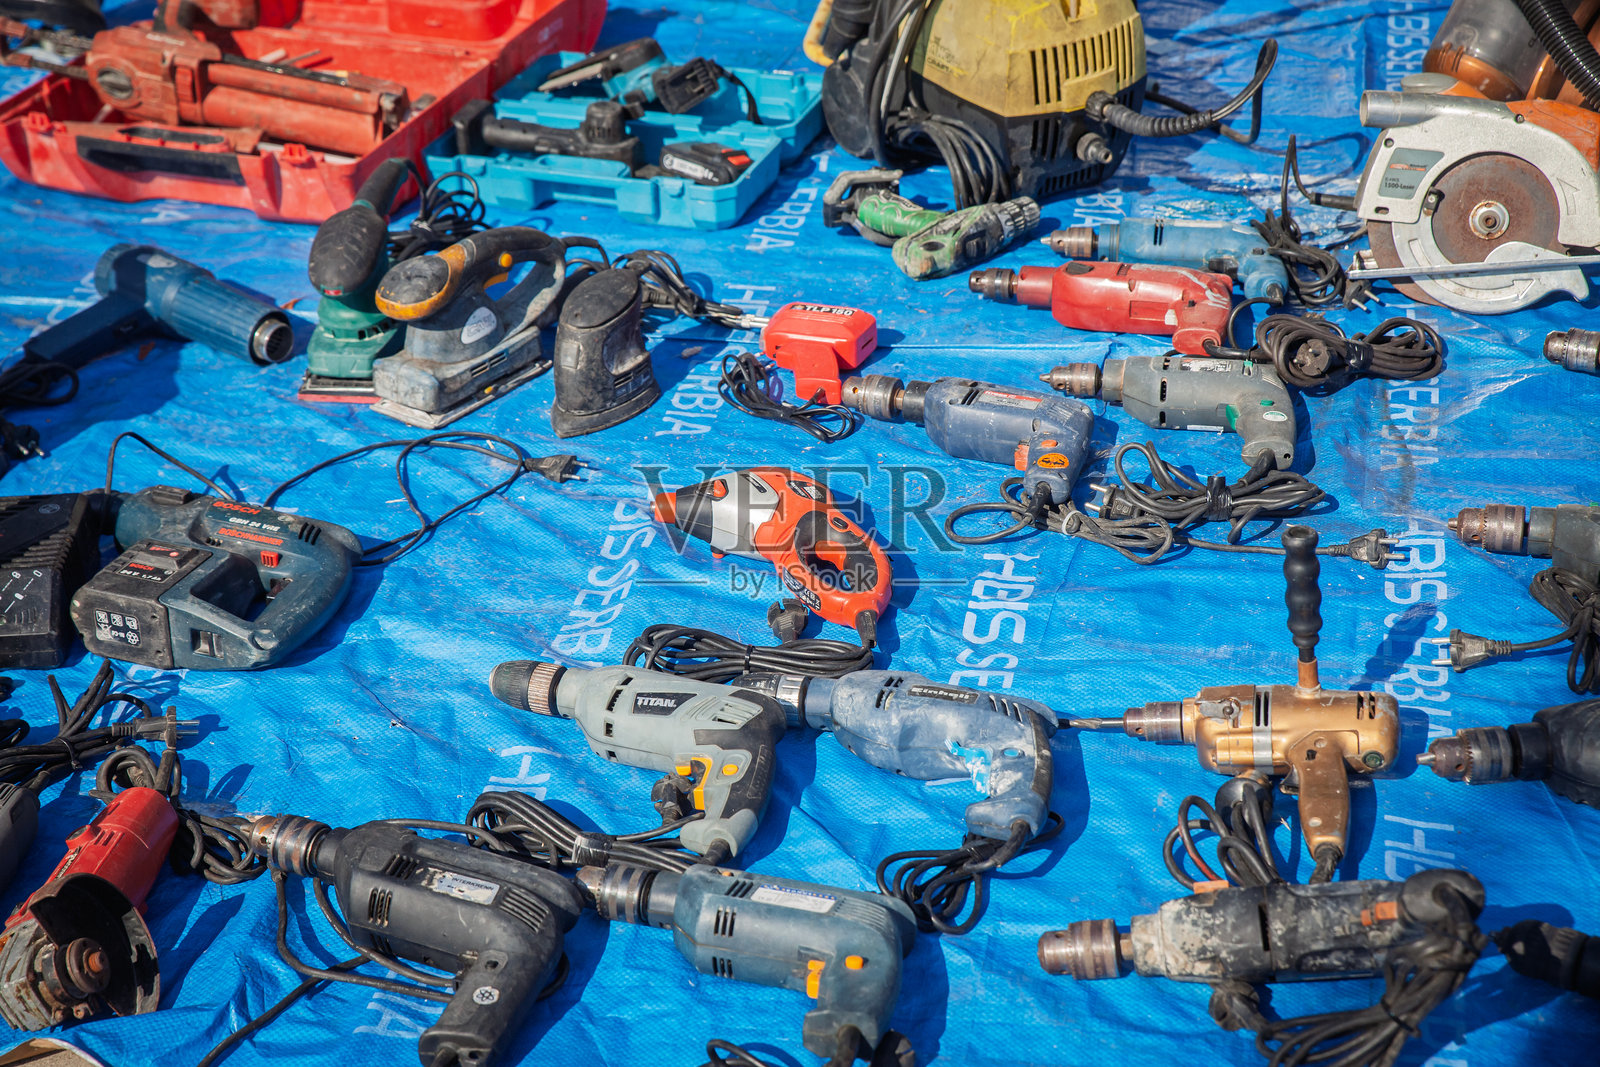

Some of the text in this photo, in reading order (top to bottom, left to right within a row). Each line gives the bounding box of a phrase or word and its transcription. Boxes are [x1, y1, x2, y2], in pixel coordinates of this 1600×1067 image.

[805, 305, 830, 313] TLP
[832, 308, 853, 316] 150
[212, 501, 261, 515] BOSCH
[262, 524, 281, 532] VRE
[637, 697, 677, 707] TITAN
